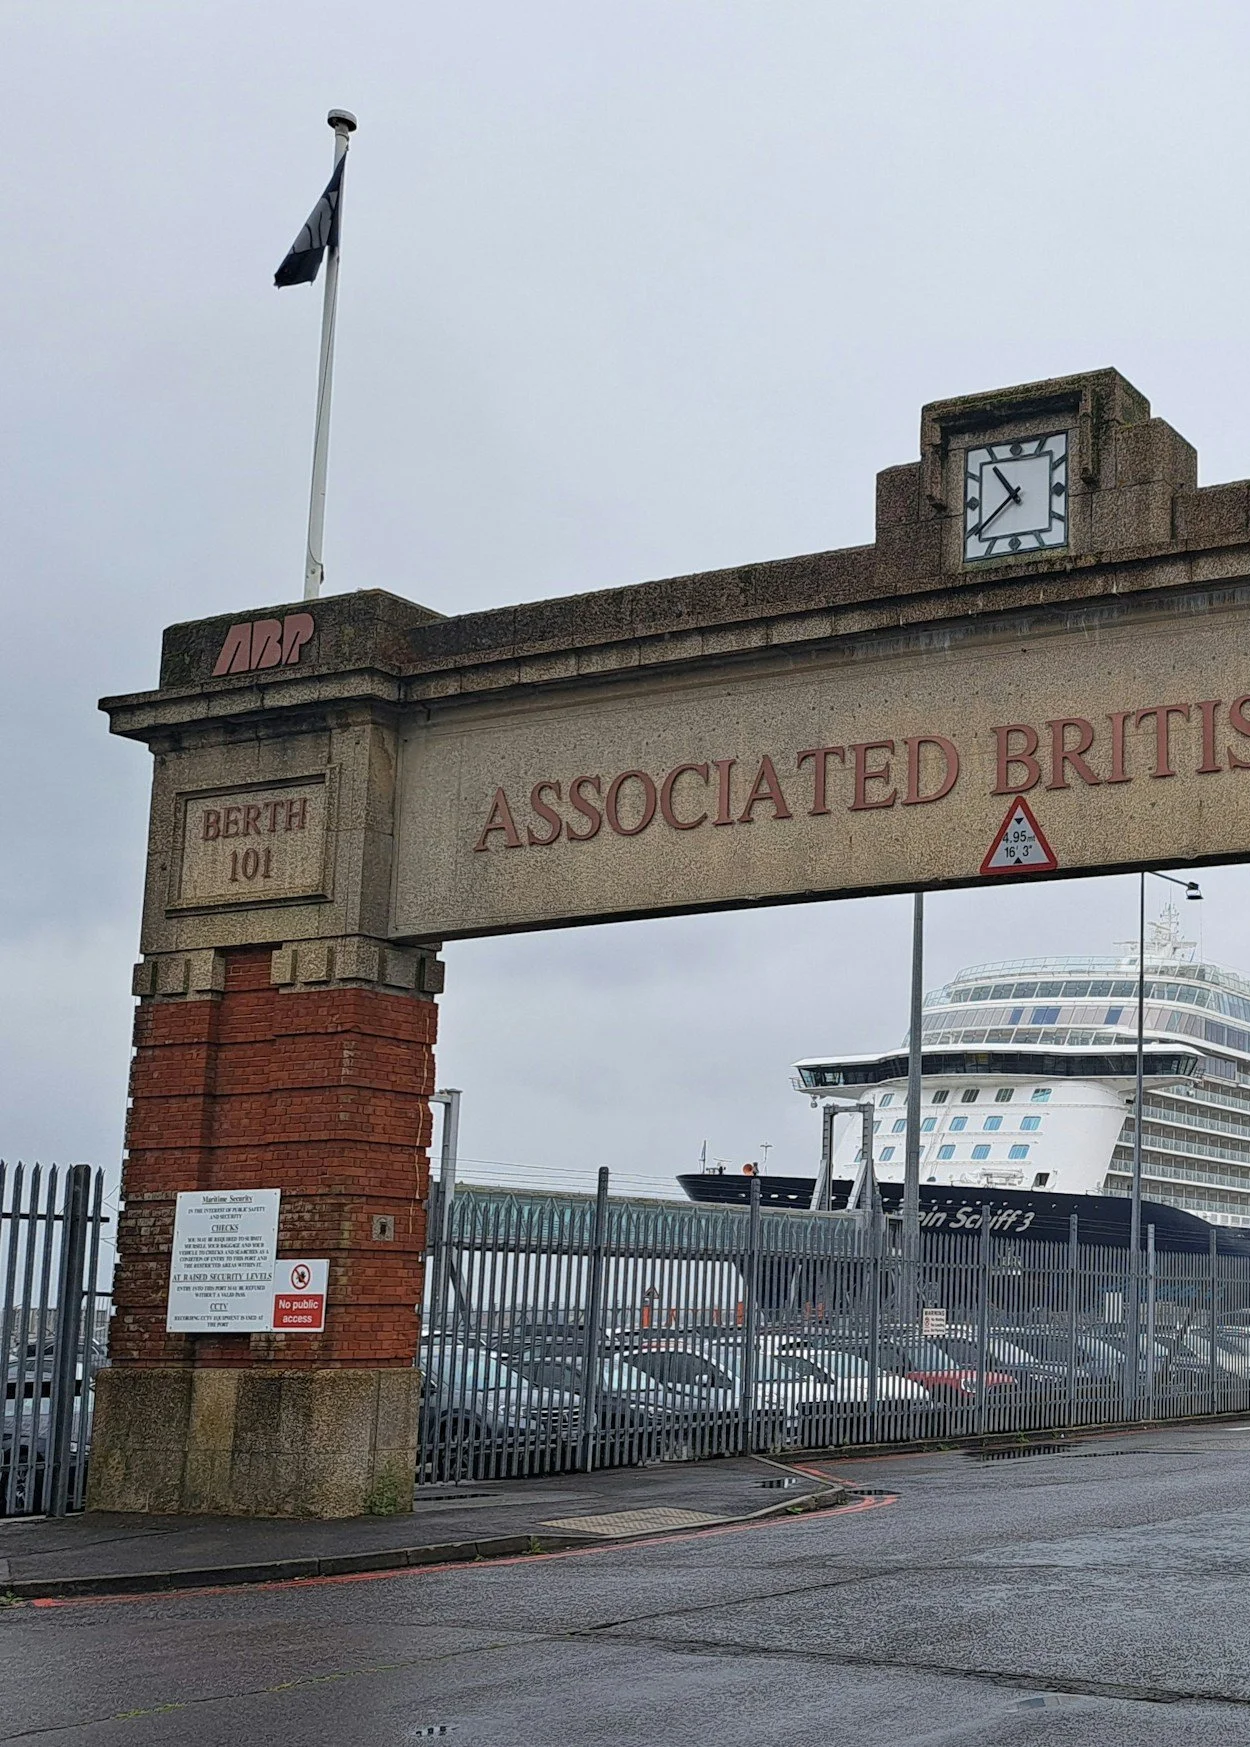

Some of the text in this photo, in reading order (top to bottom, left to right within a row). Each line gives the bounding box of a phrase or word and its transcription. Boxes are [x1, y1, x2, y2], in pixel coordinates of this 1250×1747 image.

[212, 612, 315, 677] ABP
[473, 734, 960, 854] ASSOCIATED
[202, 798, 308, 841] BERTH
[229, 846, 273, 884] 101
[202, 1194, 253, 1203] Maritime Security
[211, 1224, 239, 1232] CHECKS
[1015, 1210, 1035, 1232] 3
[279, 1298, 319, 1312] No public
[282, 1314, 312, 1324] access
